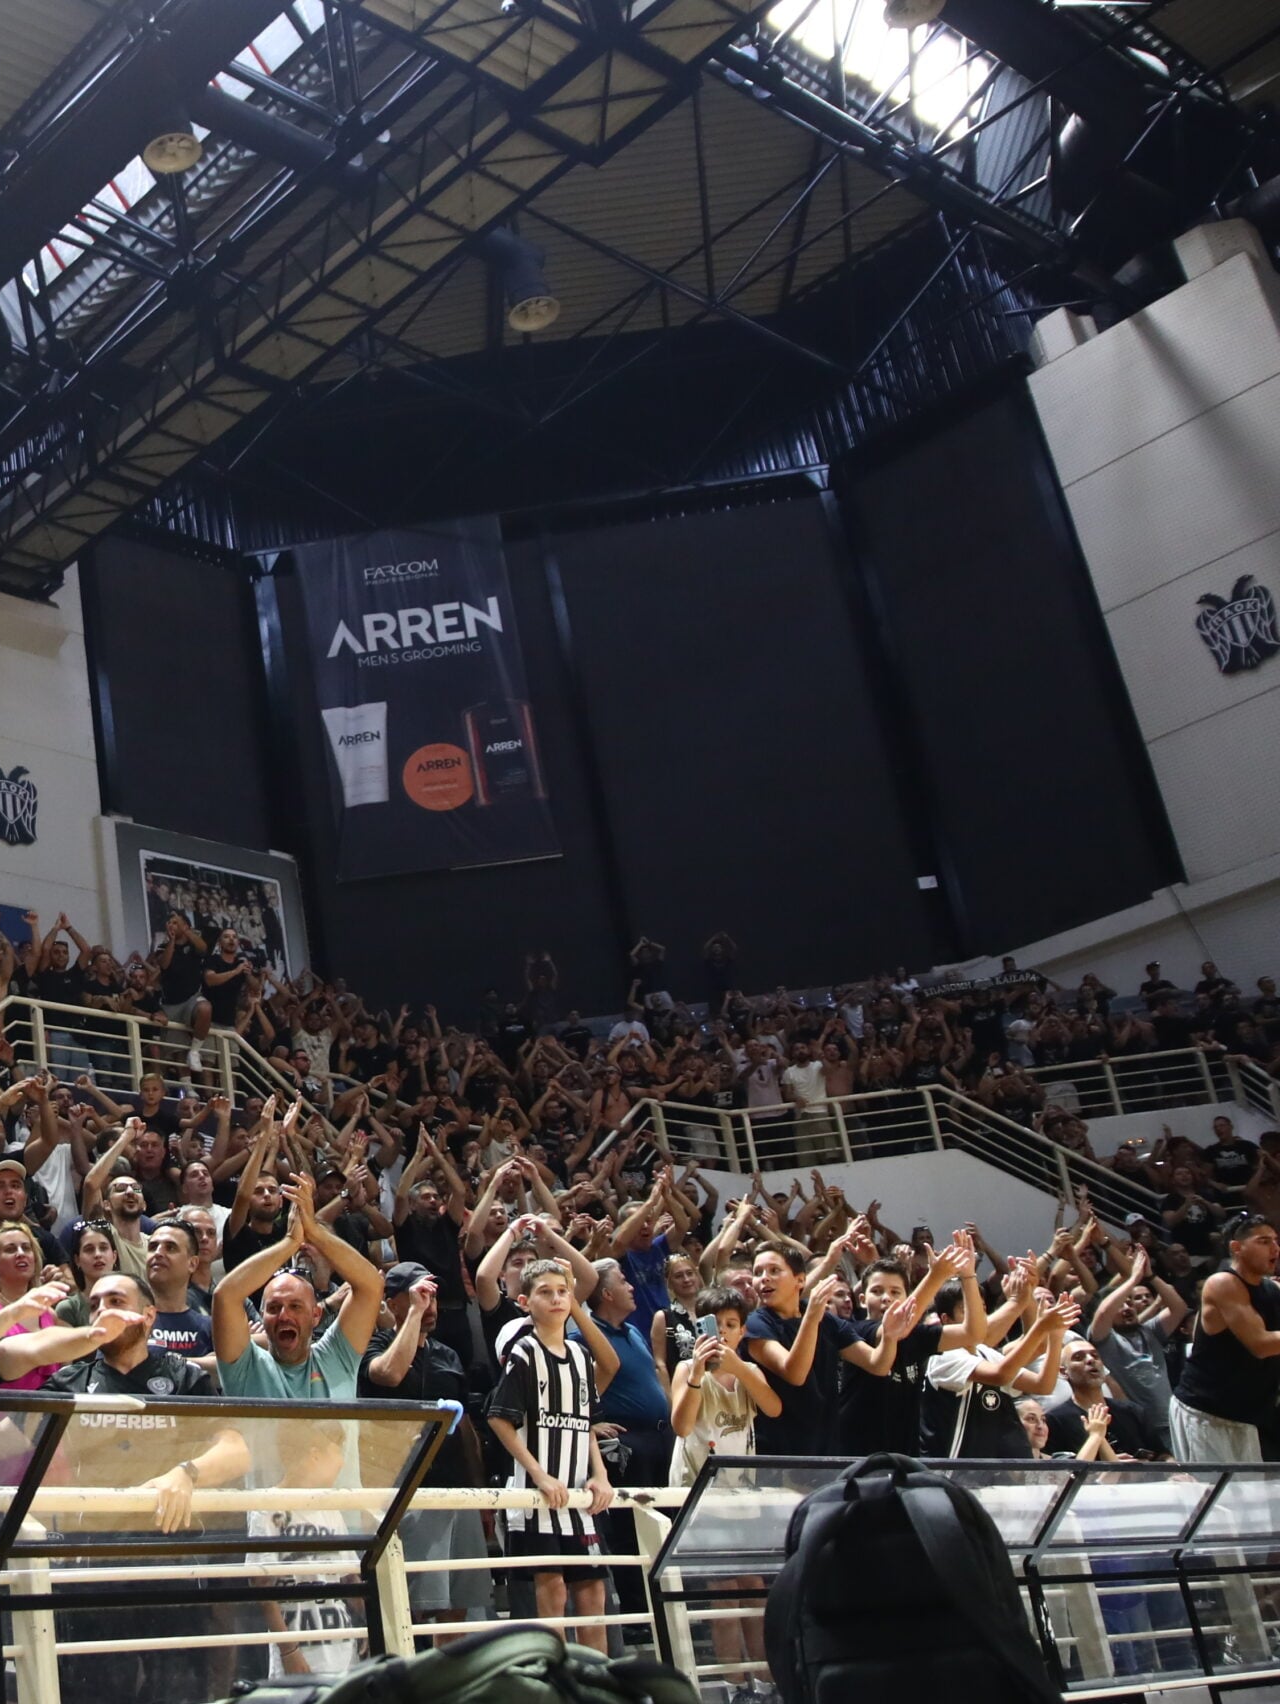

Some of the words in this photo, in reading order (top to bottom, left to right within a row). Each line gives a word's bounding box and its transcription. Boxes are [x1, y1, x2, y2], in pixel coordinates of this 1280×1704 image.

[363, 558, 439, 580] FARCOM
[365, 571, 439, 586] PROFESSIONAL
[1212, 601, 1254, 626] ΠΑΟΚ
[326, 596, 503, 658] ARREN
[401, 640, 482, 663] GROOMING
[338, 730, 381, 746] ARREN
[486, 739, 522, 753] ARREN
[417, 757, 461, 772] ARREN
[149, 1328, 198, 1343] OMMY
